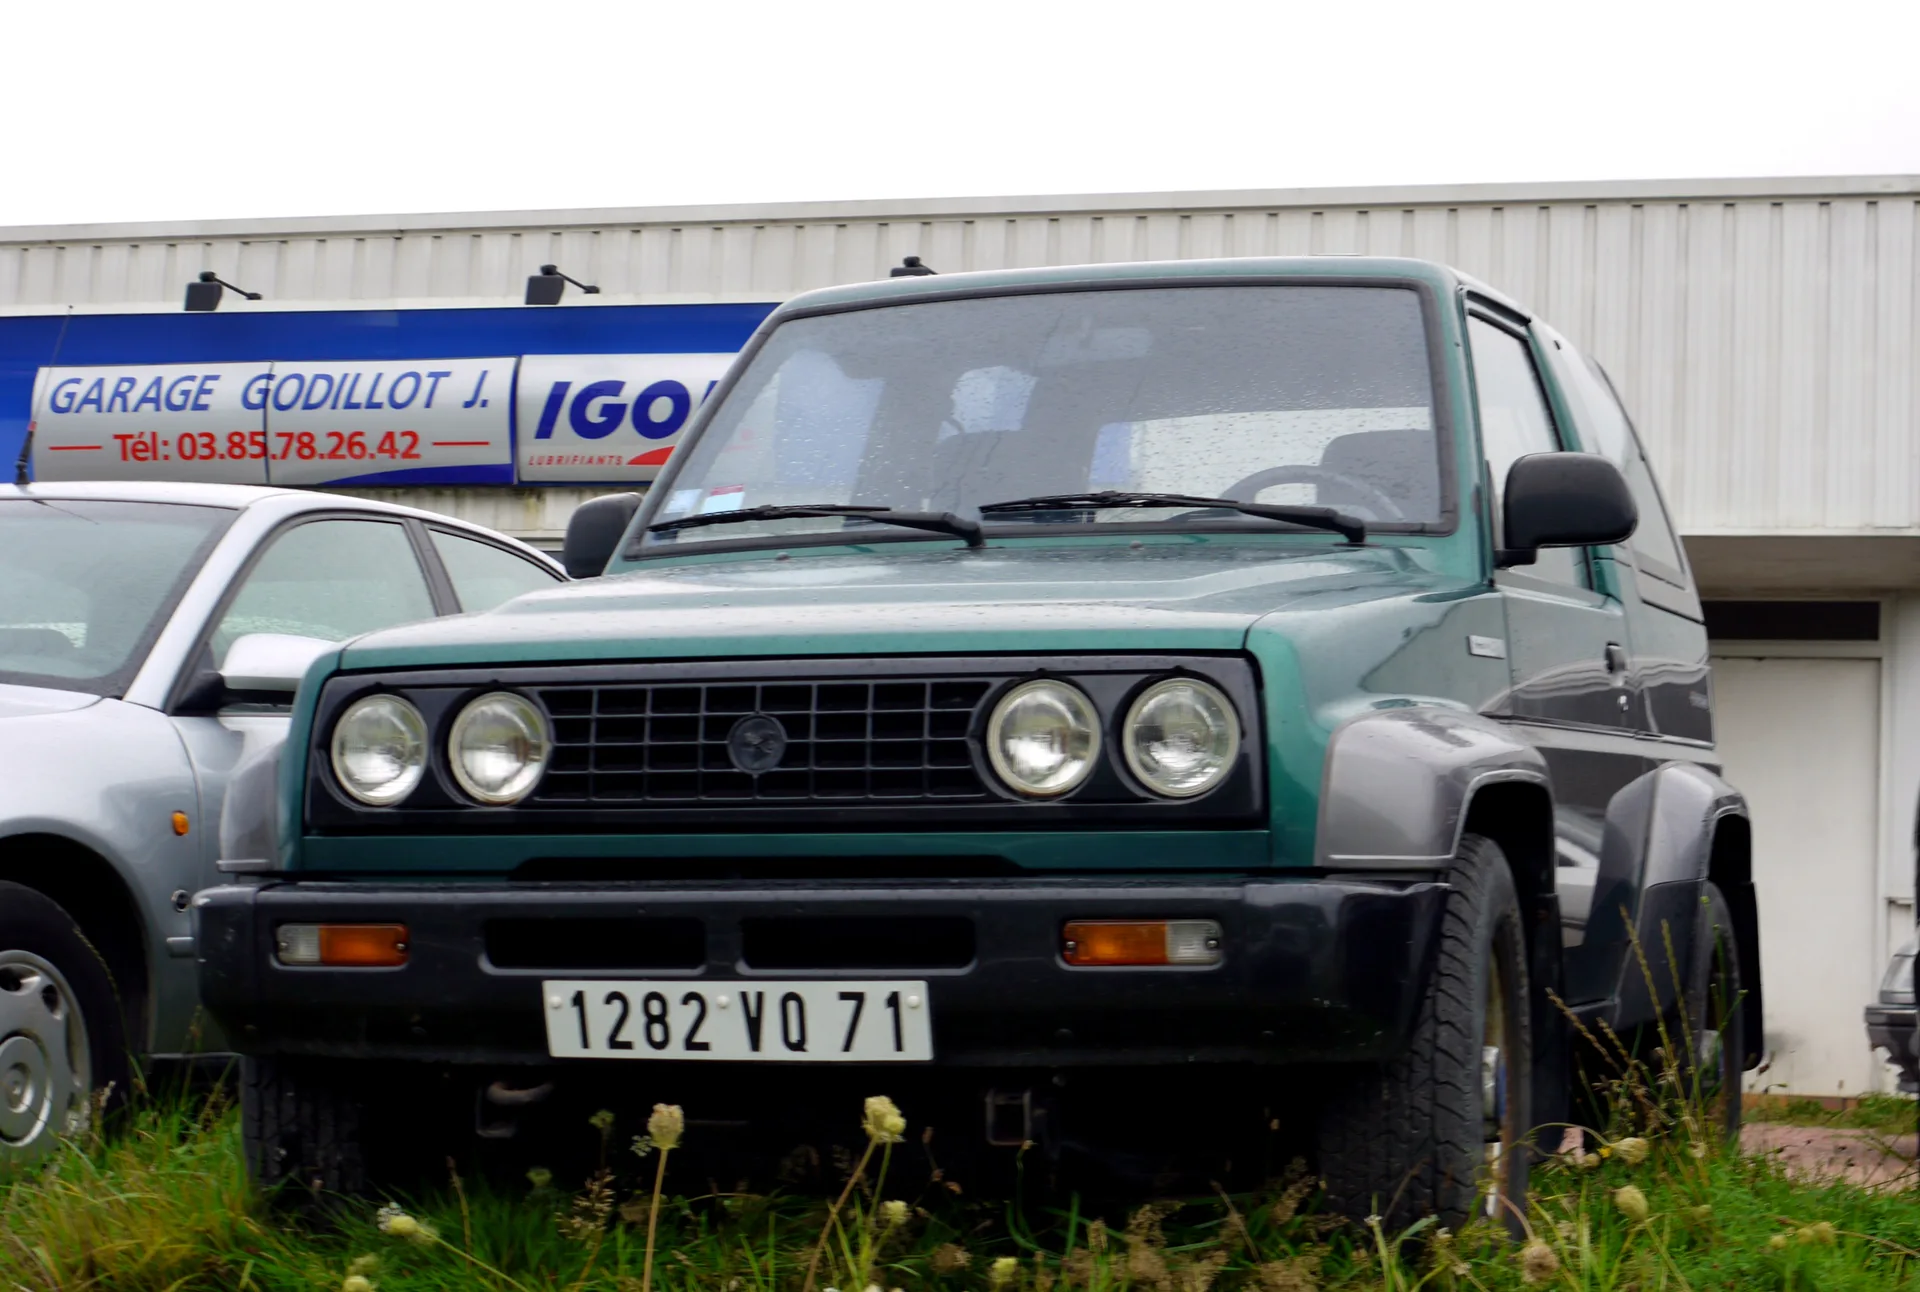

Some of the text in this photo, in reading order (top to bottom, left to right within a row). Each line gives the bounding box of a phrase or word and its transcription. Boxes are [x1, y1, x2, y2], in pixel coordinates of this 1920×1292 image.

[50, 370, 489, 414] GARAGE GODILLOT J.
[113, 430, 422, 462] Tél: 03.85.78.26.42
[528, 454, 624, 466] LUBRIFIANTS
[570, 990, 906, 1053] 1282 VQ 71
